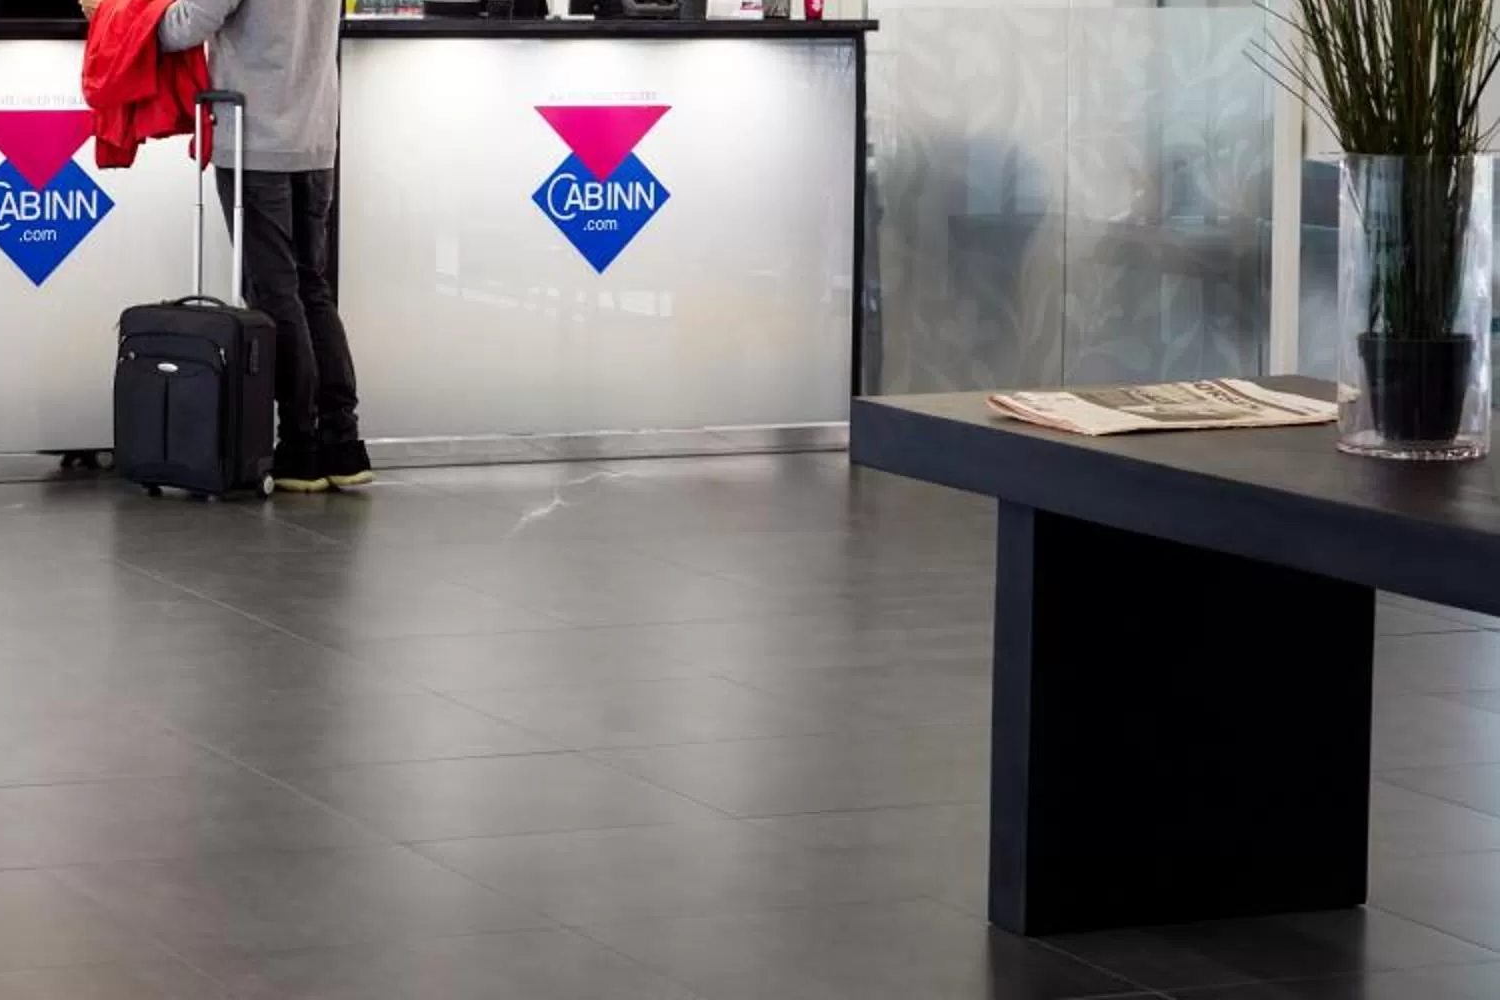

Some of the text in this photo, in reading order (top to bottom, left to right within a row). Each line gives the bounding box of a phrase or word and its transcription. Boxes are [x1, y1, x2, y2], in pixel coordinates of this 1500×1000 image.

[548, 173, 655, 220] CABINN
[583, 219, 617, 231] .com
[19, 228, 57, 242] .com
